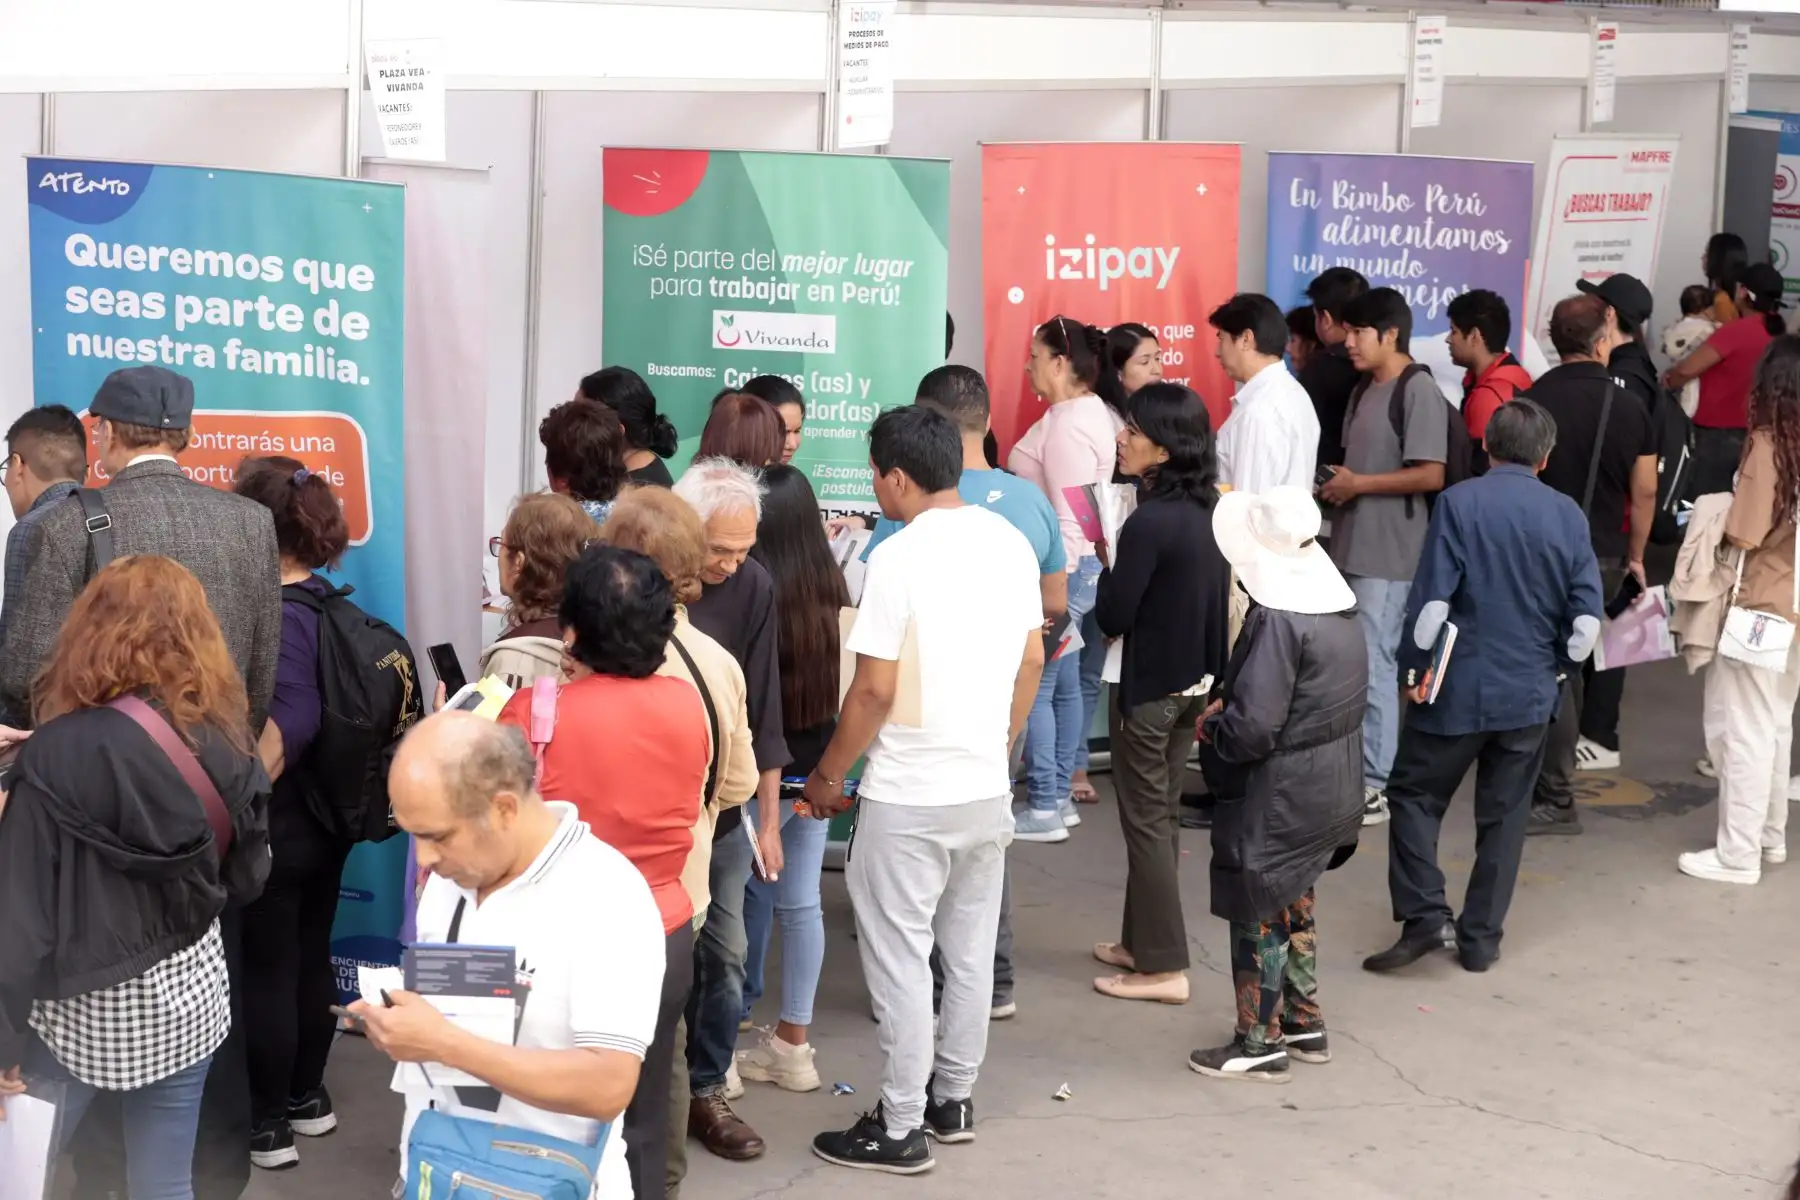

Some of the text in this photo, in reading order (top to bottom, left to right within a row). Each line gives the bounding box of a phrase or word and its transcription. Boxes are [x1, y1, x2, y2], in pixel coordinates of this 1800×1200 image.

[844, 41, 864, 49] MEDIOS
[865, 41, 873, 49] DE
[848, 29, 884, 38] PROCESOS DE
[379, 69, 405, 78] PLAZA
[408, 68, 425, 77] VEA
[386, 82, 424, 92] VIVANDA
[1631, 151, 1672, 163] MAPFRE
[38, 172, 130, 195] ATENTO
[1289, 177, 1487, 217] En Bimbo Perú
[1322, 215, 1512, 255] alimentamos
[64, 233, 375, 294] Queremos que
[633, 242, 914, 282] ¡Sé parte del mejor lugar
[1045, 233, 1180, 290] izipay
[1293, 248, 1428, 278] un mundo
[650, 275, 900, 306] para trabajar en Perú!
[65, 285, 370, 340] seas parte de
[744, 329, 829, 349] Vivanda
[1163, 324, 1195, 344] que
[67, 332, 370, 385] nuestra familia.
[647, 363, 716, 379] Buscamos:
[812, 371, 852, 394] (as)
[859, 378, 871, 399] y
[290, 436, 335, 452] una
[804, 427, 857, 439] aprender
